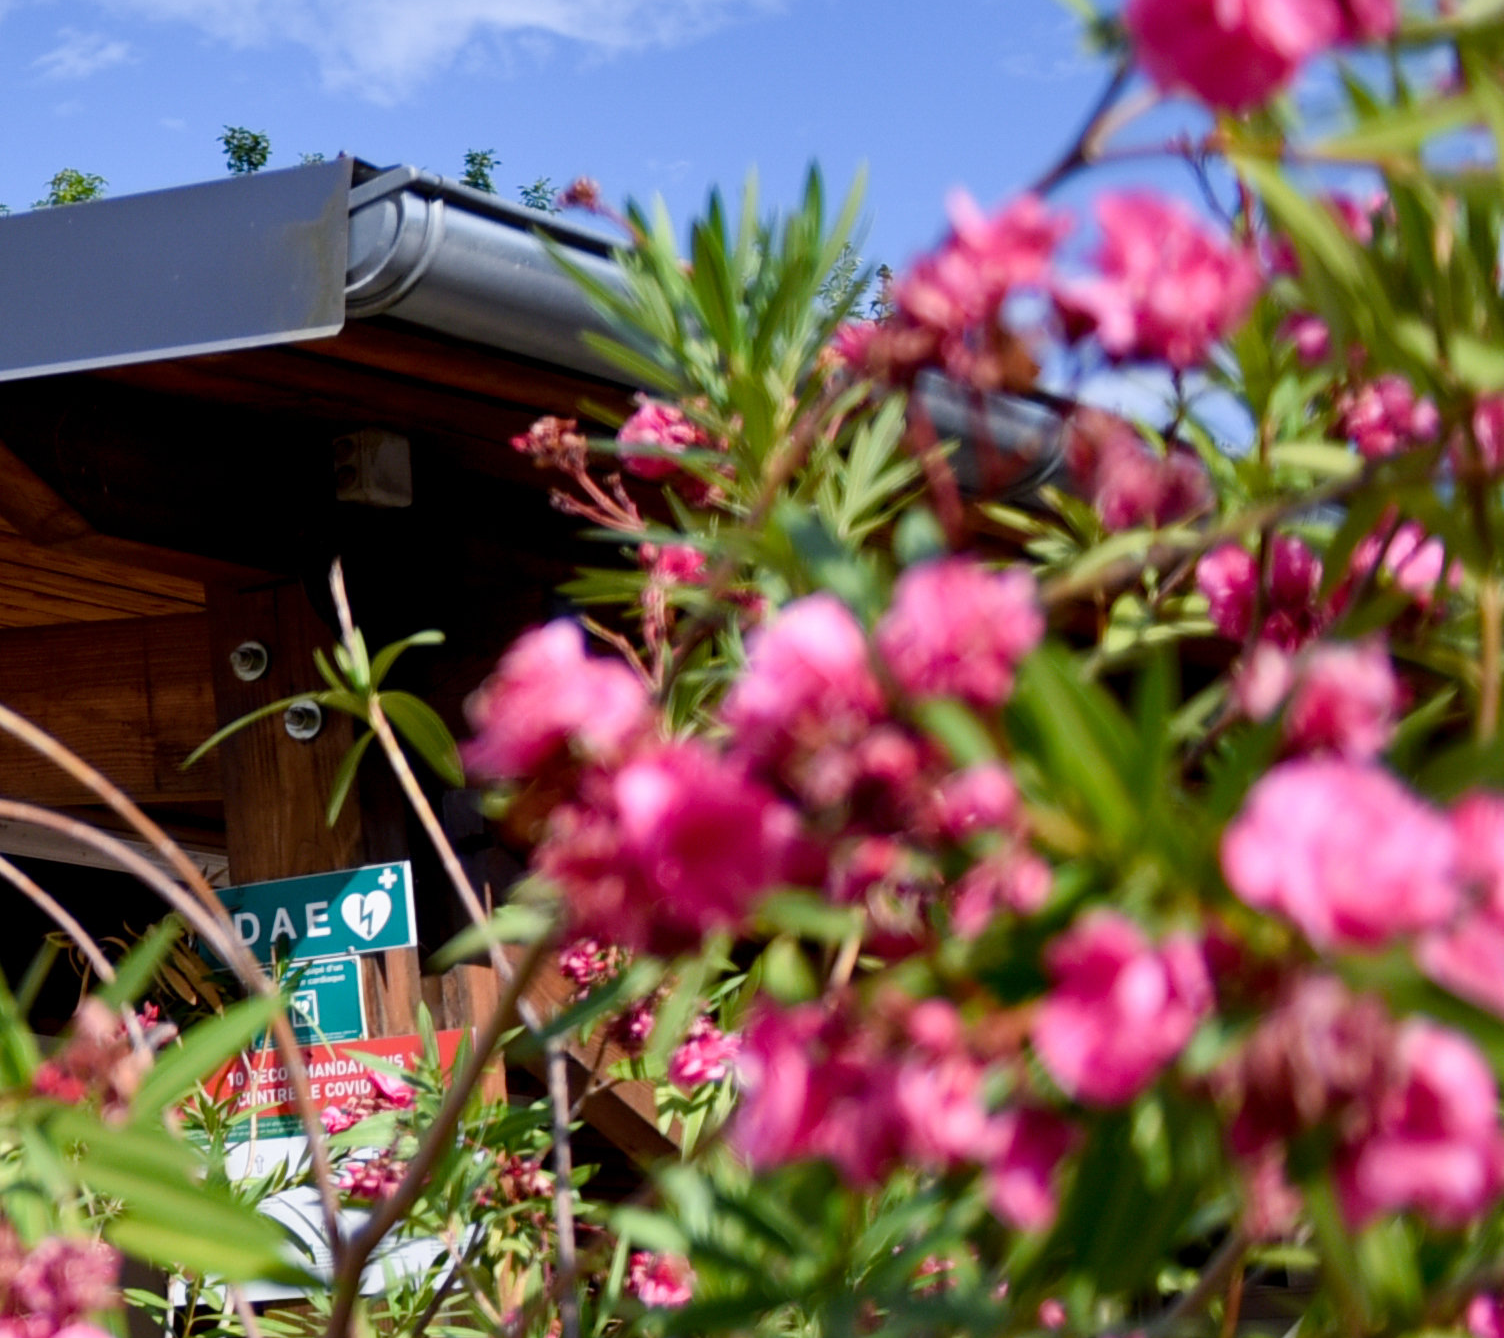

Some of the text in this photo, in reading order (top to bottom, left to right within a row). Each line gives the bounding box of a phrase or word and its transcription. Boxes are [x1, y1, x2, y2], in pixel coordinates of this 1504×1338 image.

[234, 901, 331, 946] DAE
[227, 1072, 244, 1087] 10
[325, 1079, 371, 1098] COVID
